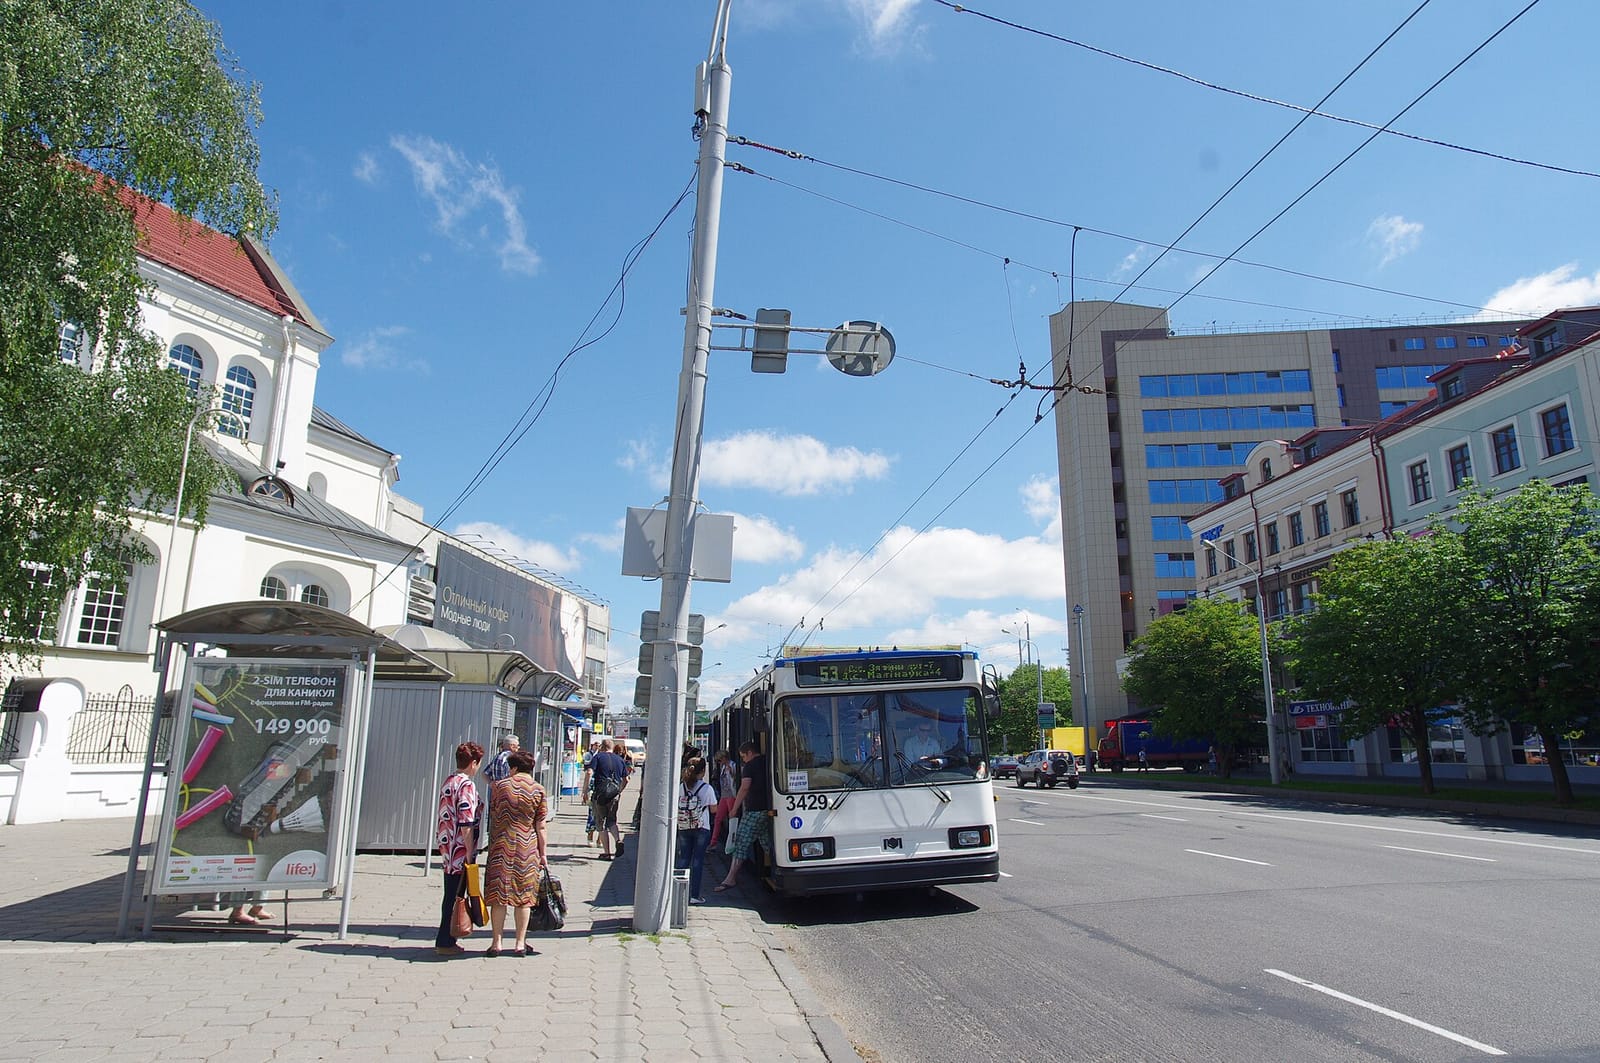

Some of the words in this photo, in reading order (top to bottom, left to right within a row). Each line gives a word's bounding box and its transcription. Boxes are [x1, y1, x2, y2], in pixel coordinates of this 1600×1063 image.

[443, 586, 487, 615] Отличный
[488, 606, 509, 623] кофе
[440, 604, 472, 626] Модные
[472, 618, 491, 632] люди
[253, 676, 283, 685] 2-SIM
[285, 676, 336, 686] ТЕЛЕФОН
[819, 665, 839, 681] 53
[264, 688, 286, 698] ДЛЯ
[287, 689, 335, 698] КАНИКУЛ
[255, 718, 291, 734] 149
[294, 718, 331, 734] 900
[309, 735, 329, 745] руб.
[786, 794, 828, 811] 3429
[286, 862, 317, 877] life:)
